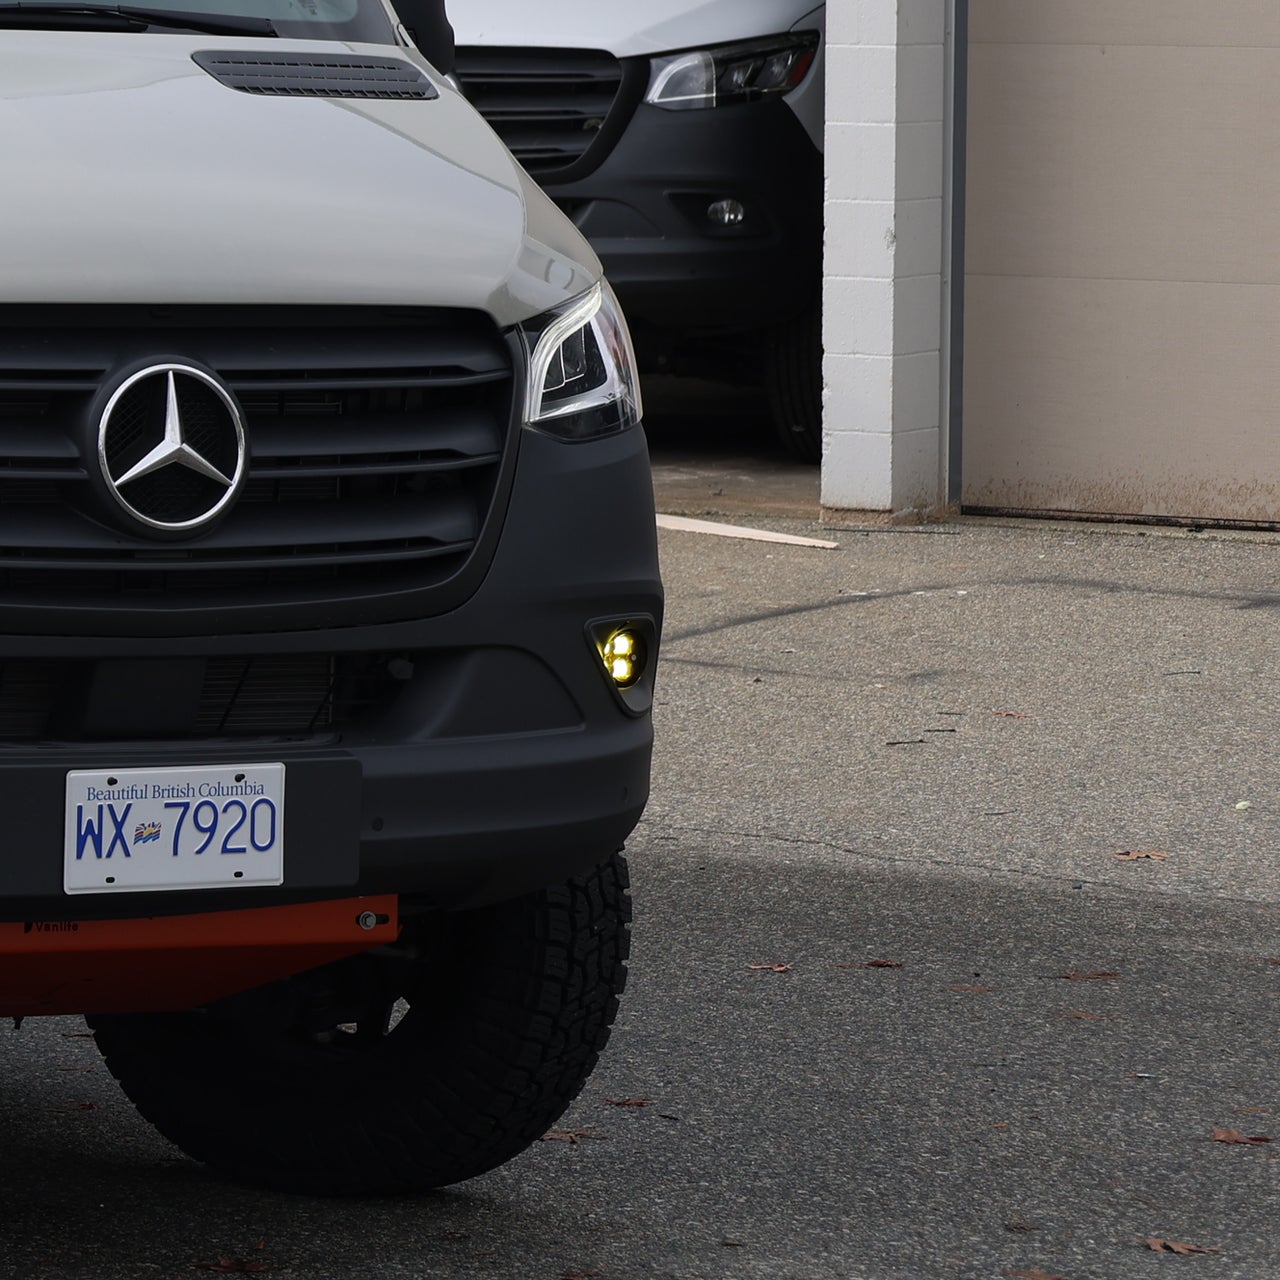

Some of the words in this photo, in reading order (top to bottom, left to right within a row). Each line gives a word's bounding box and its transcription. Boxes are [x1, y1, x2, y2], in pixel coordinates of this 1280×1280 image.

[86, 784, 148, 801] Beautiful
[152, 783, 195, 799] British
[198, 781, 265, 797] Columbia
[75, 802, 132, 860] WX
[163, 797, 277, 857] 7920
